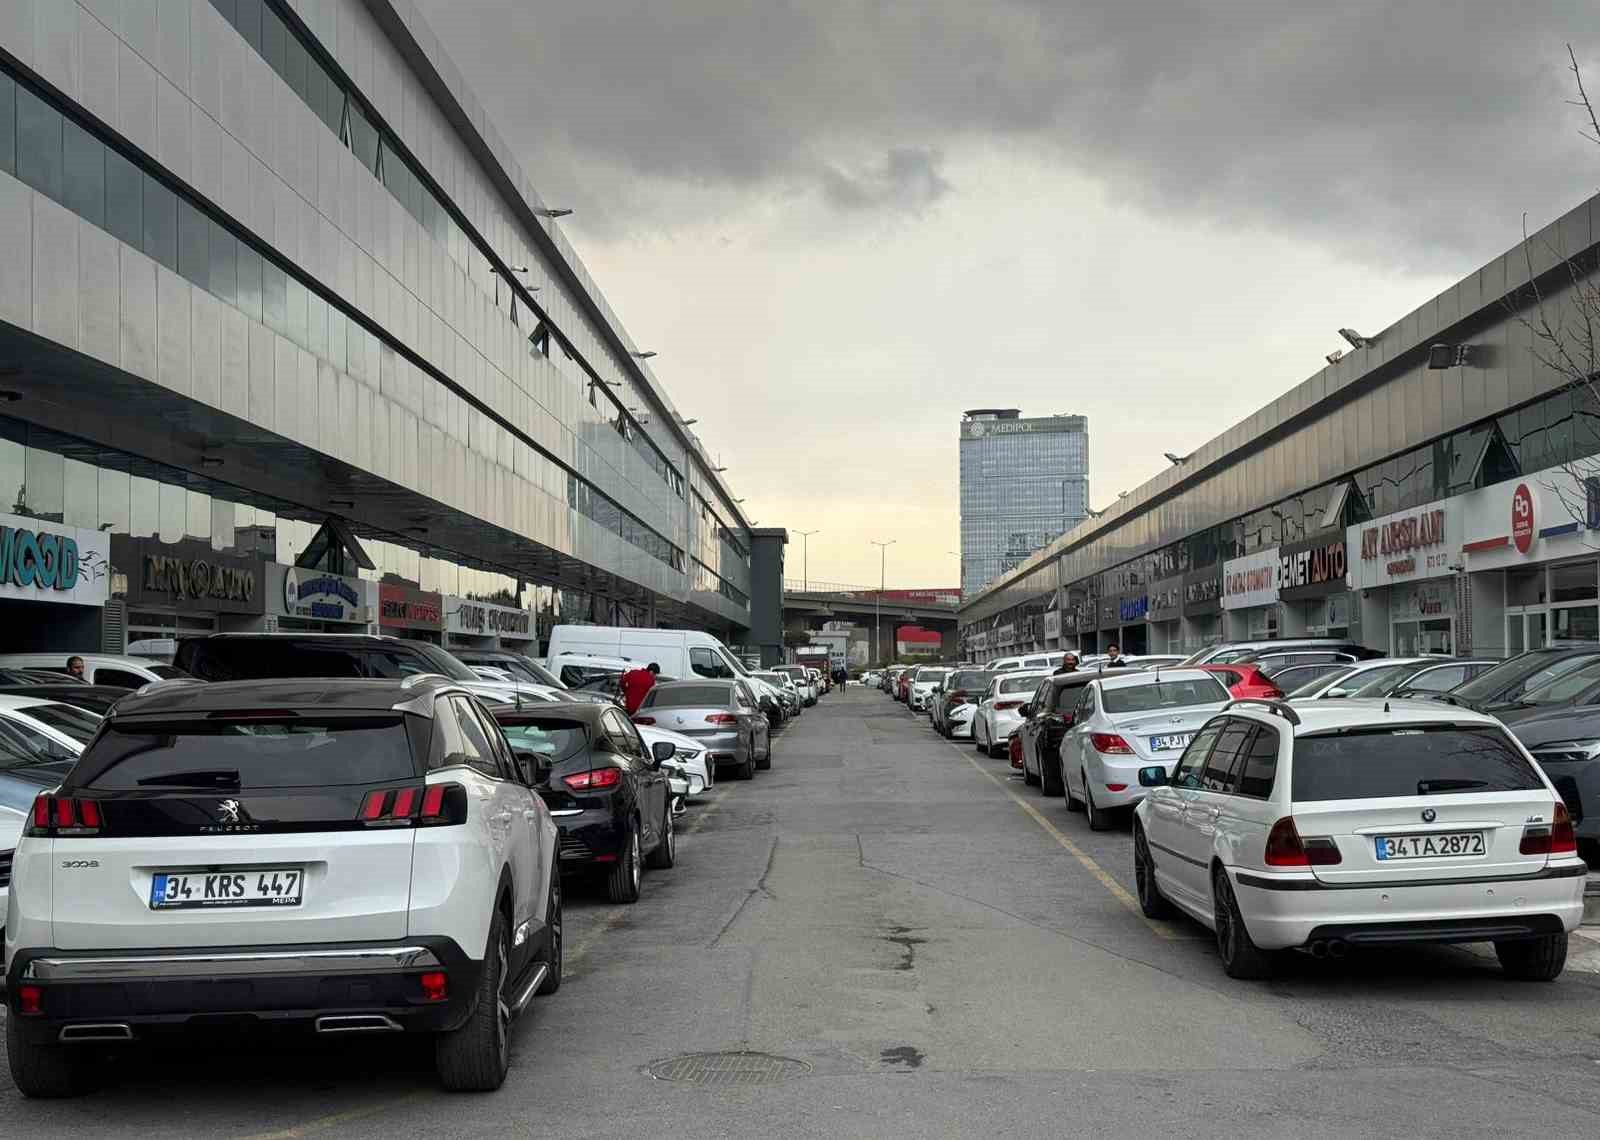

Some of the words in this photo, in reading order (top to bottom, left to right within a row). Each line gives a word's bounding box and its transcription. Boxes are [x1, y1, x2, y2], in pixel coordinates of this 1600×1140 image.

[1312, 543, 1345, 583] AUTO
[1387, 839, 1408, 856] 34
[1410, 838, 1437, 855] TA
[1439, 835, 1483, 854] 2872
[166, 877, 193, 899] 34
[204, 874, 246, 898] KRS
[257, 873, 298, 896] 447
